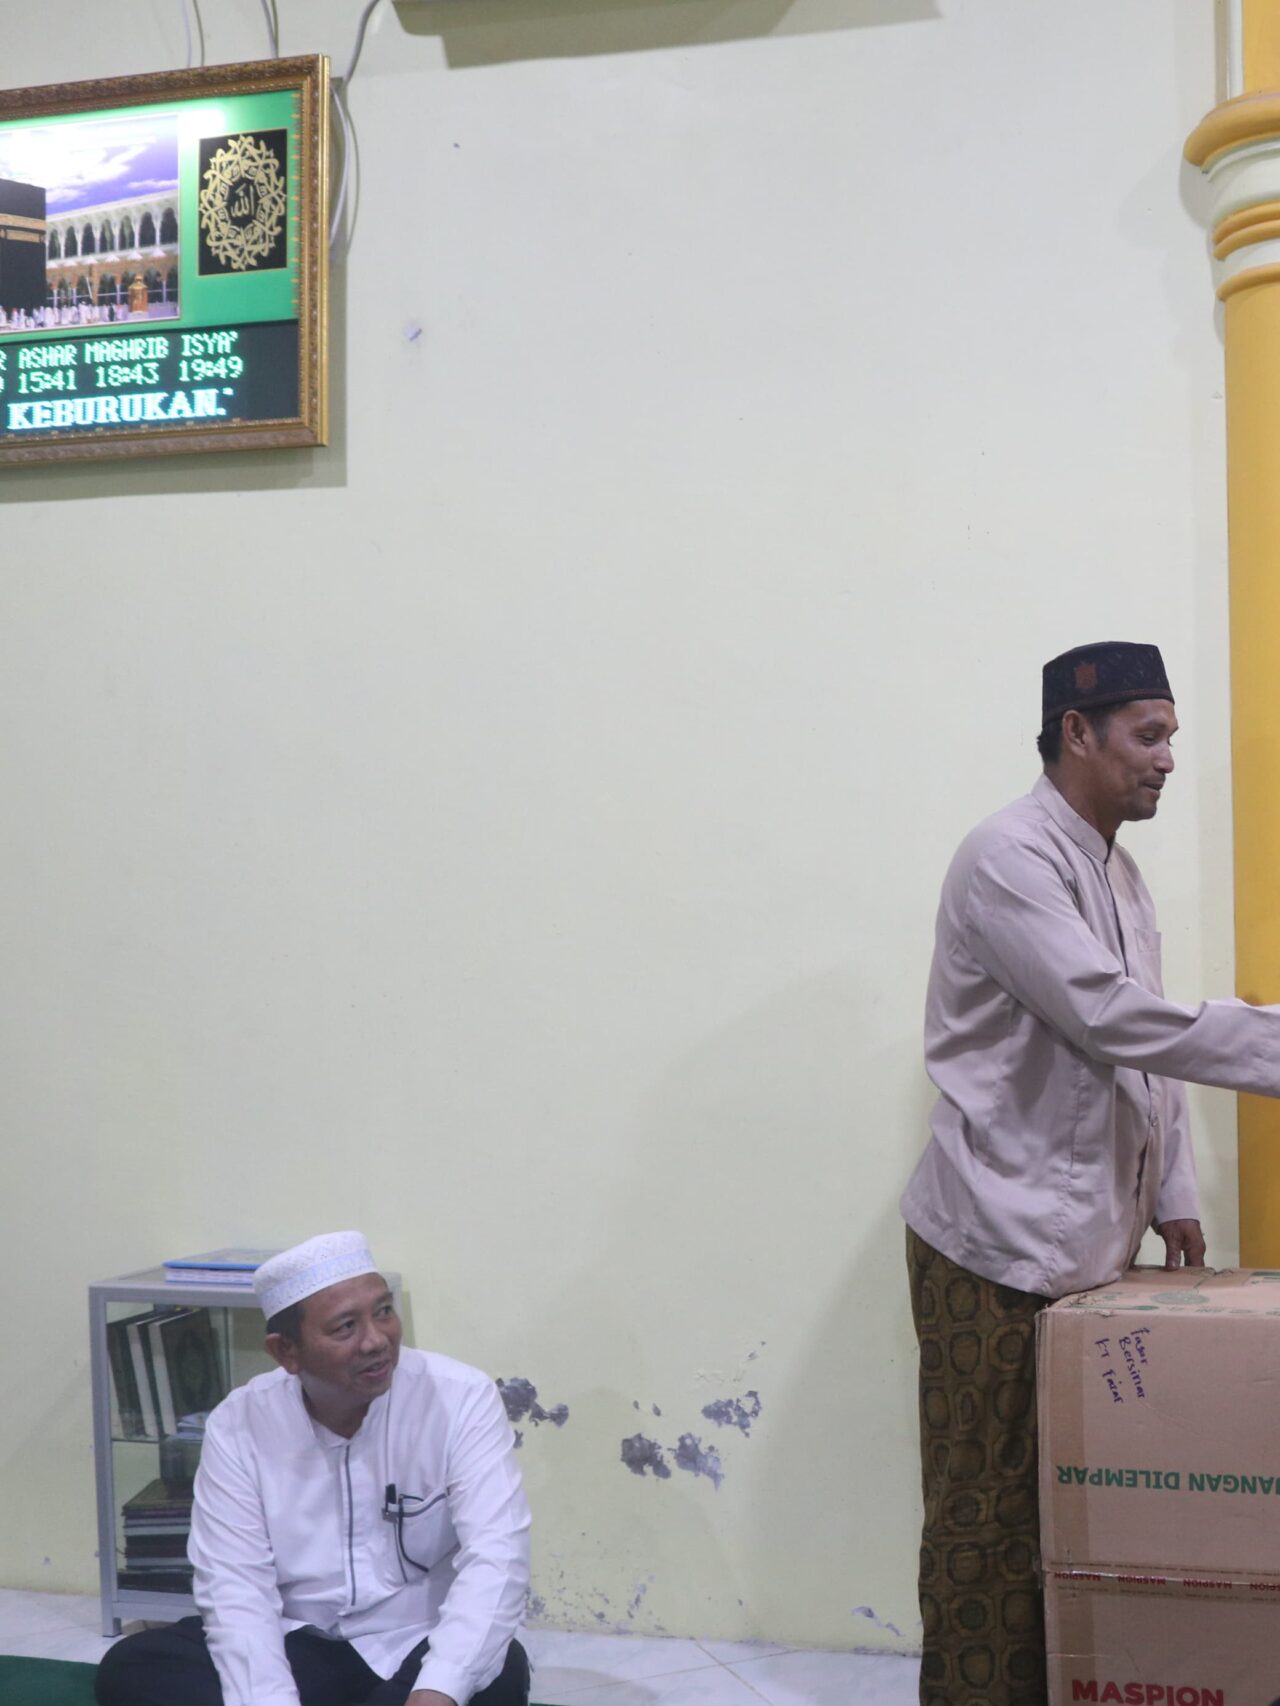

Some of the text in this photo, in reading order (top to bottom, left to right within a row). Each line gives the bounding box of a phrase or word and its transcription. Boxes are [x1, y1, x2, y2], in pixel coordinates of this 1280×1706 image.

[18, 344, 77, 369] ASHAR
[84, 336, 169, 364] MAGHRIB
[18, 369, 77, 394] 15:41
[96, 362, 159, 387] 18:43
[179, 356, 244, 381] 19:49
[1056, 1465, 1181, 1490] DILEMPAR
[1072, 1679, 1225, 1706] MASPION
